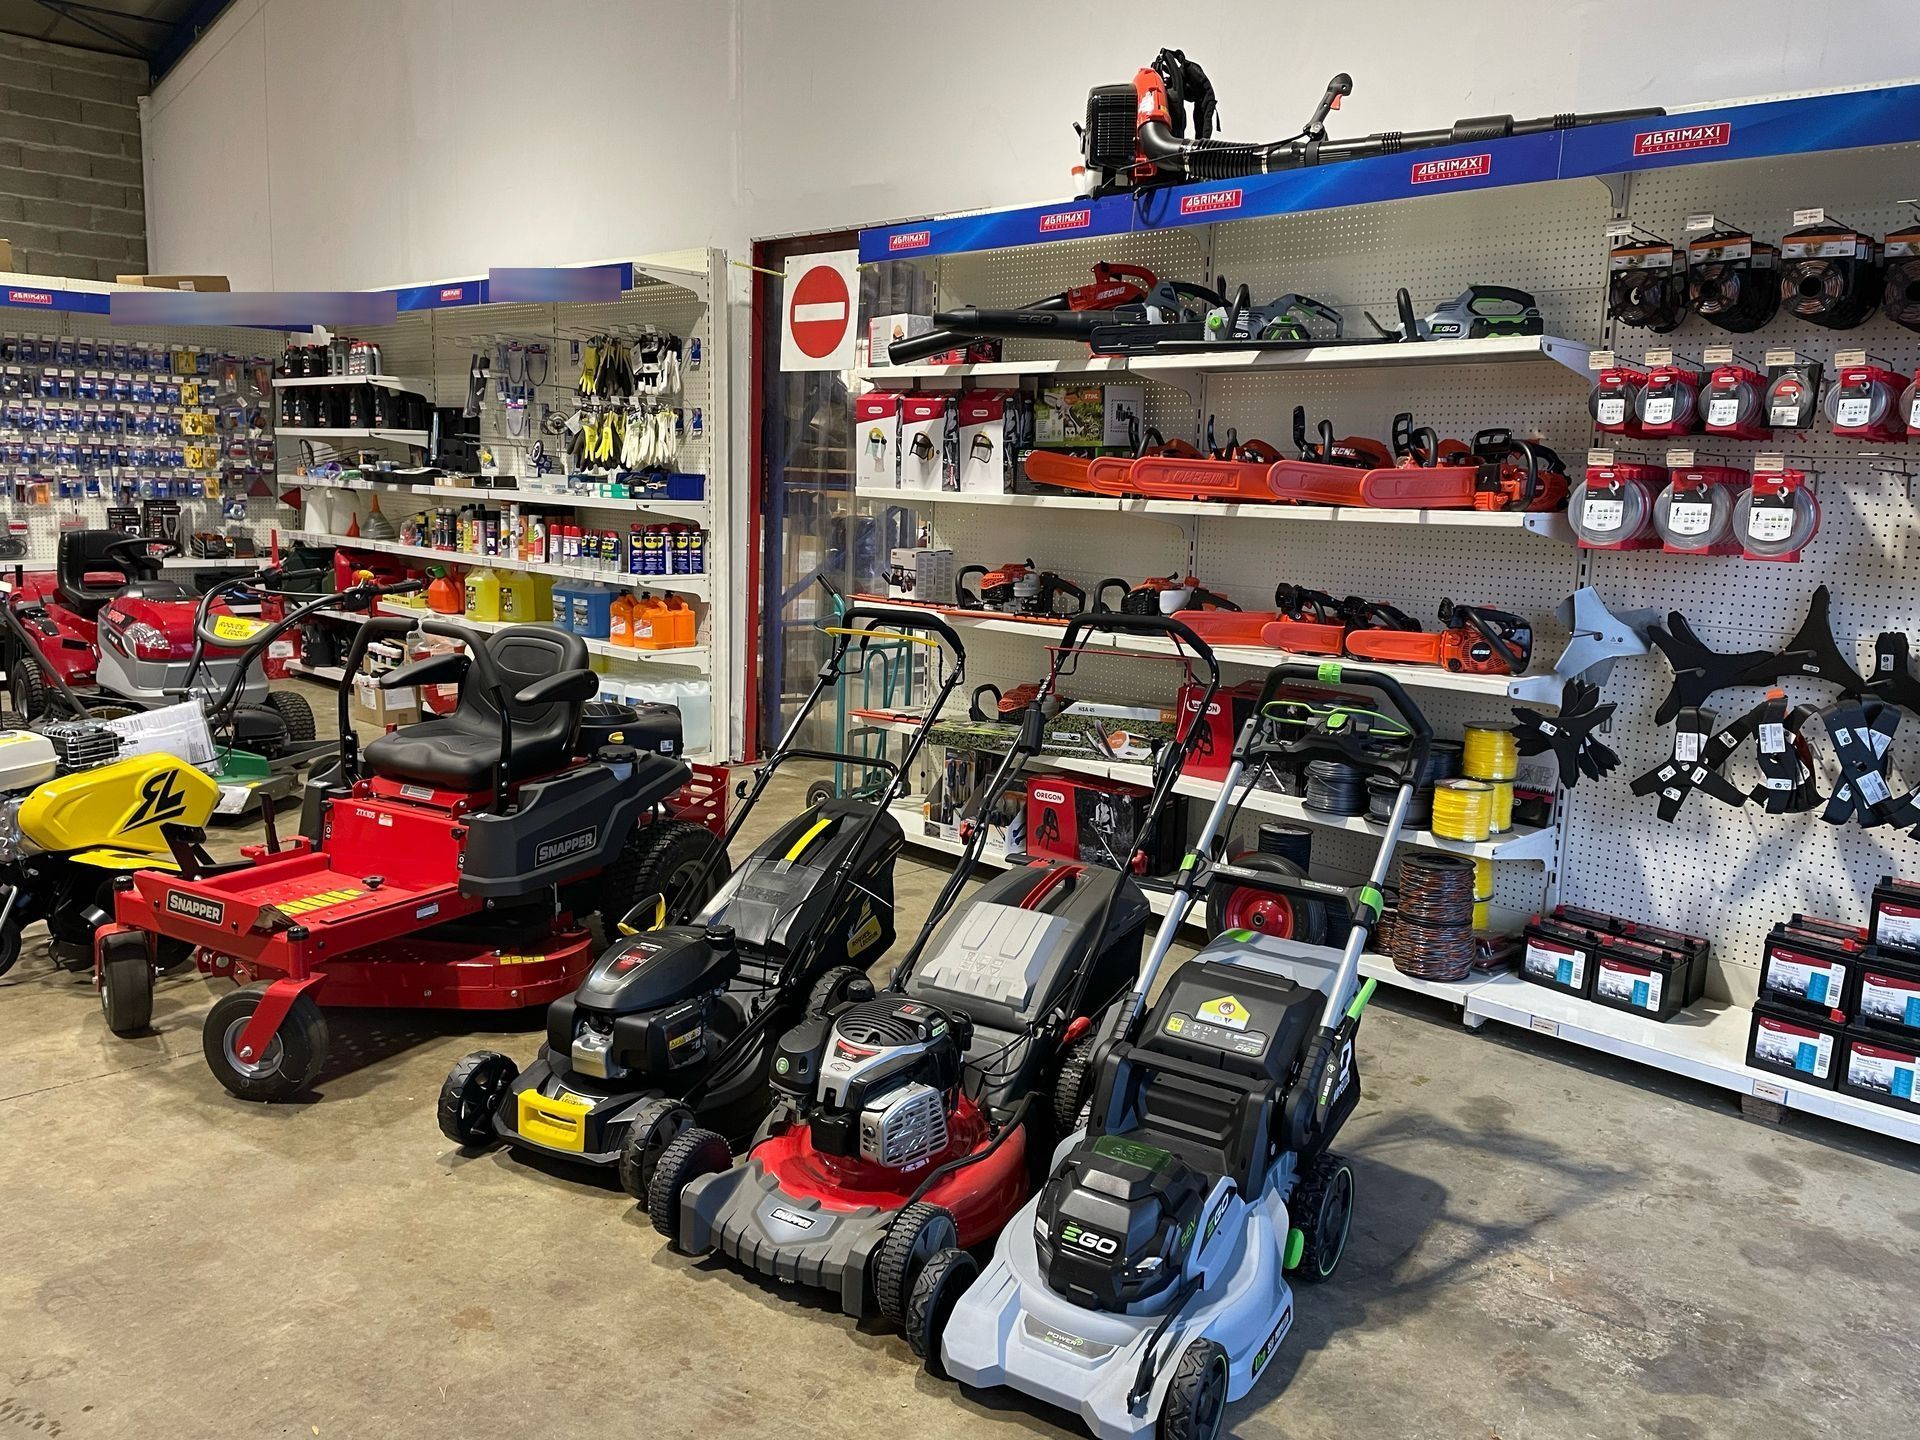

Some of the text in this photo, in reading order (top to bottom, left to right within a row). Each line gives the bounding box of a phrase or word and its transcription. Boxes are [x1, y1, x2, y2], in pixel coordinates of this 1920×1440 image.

[1642, 126, 1720, 146] AGRIMAXI
[1640, 139, 1720, 153] ACCESSOIRES
[1418, 157, 1483, 175] AGRIMAXI
[1186, 192, 1236, 206] AGRIMAXI
[1044, 211, 1086, 225] AGRIMAXI
[892, 233, 926, 245] AGRIMAXI
[1103, 286, 1126, 299] ECHO
[1016, 314, 1053, 325] EGO
[1231, 331, 1249, 339] GO
[1036, 791, 1063, 801] OREGON
[539, 832, 594, 861] SNAPPER
[169, 894, 221, 921] SNAPPER
[773, 1210, 812, 1228] SNAPPER
[1206, 1193, 1230, 1239] EGO
[1061, 1224, 1118, 1254] EGO
[1180, 1215, 1197, 1248] 56V
